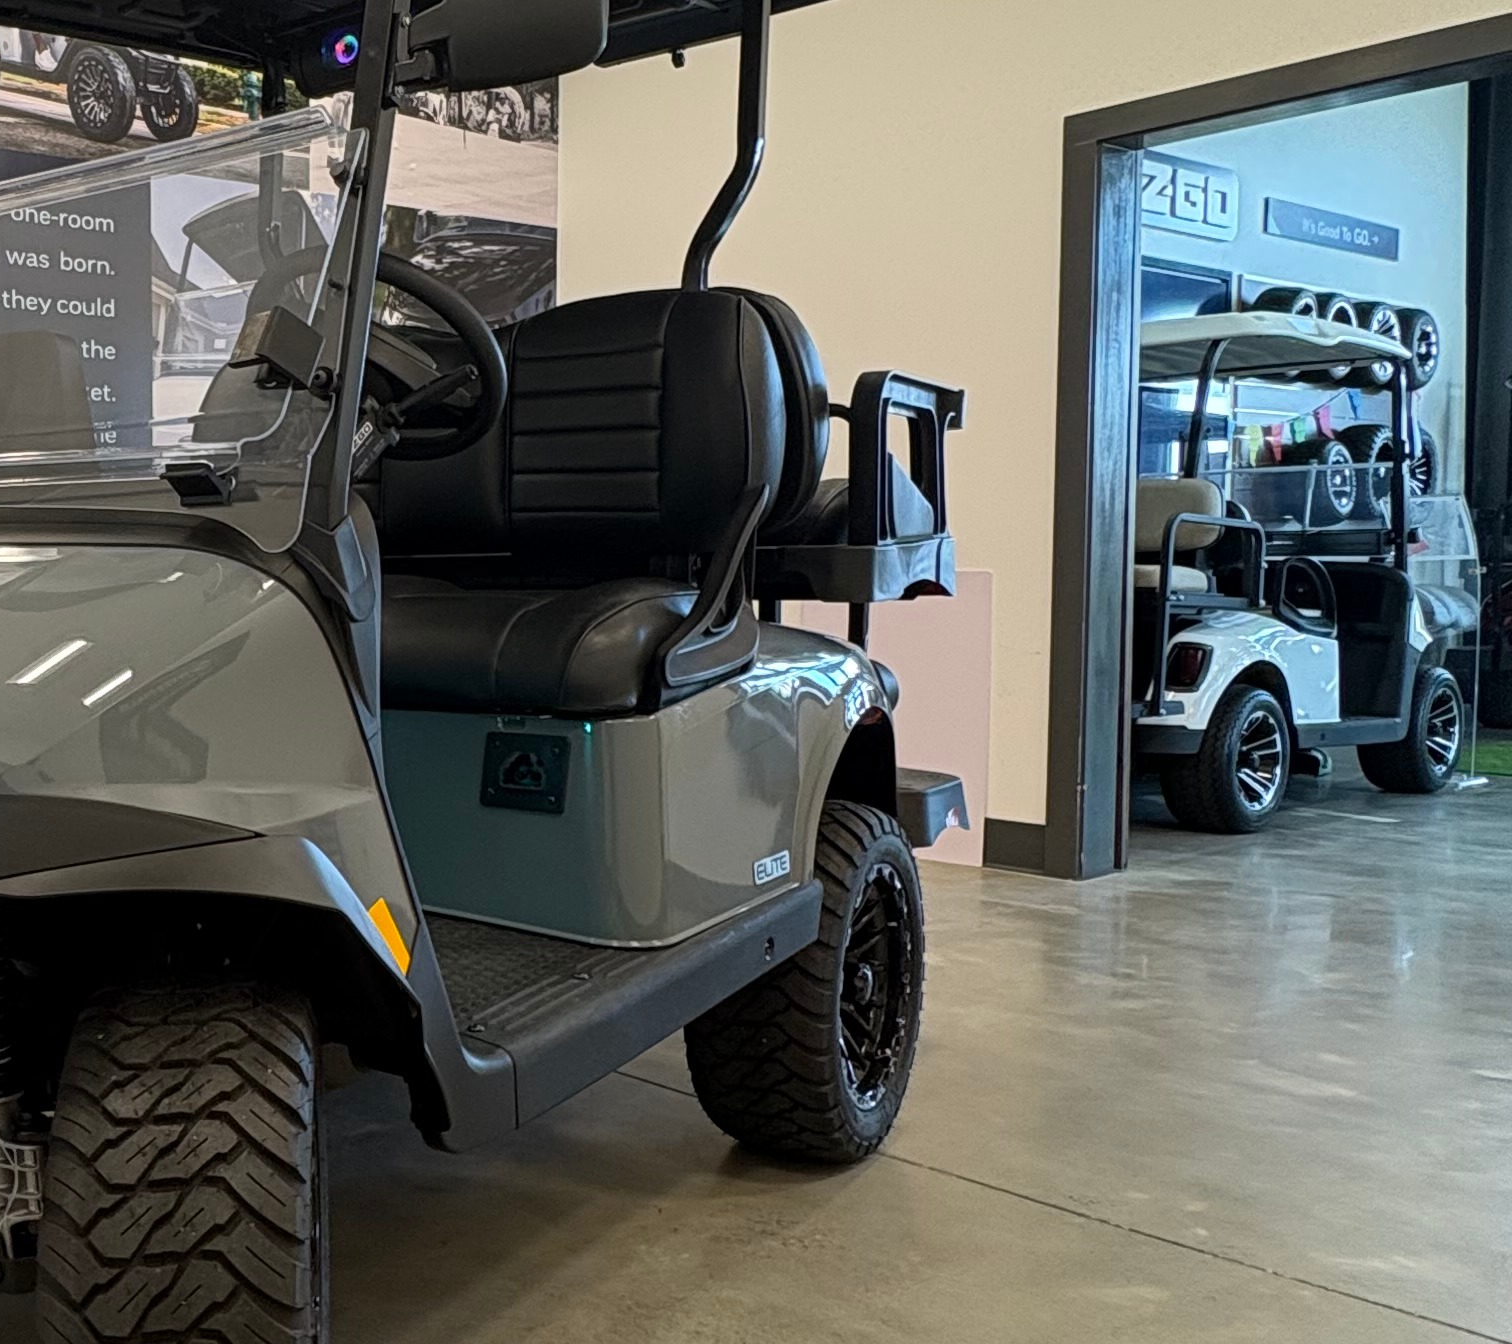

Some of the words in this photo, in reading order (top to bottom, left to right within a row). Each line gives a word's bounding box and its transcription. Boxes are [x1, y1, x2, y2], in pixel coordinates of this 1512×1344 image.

[1142, 159, 1234, 228] ZGO
[11, 208, 114, 233] one-room
[1317, 221, 1340, 239] Good
[1342, 226, 1352, 242] To
[6, 250, 50, 269] was
[60, 250, 115, 276] born.
[2, 289, 52, 315] they
[57, 298, 115, 318] could
[81, 339, 116, 360] the
[756, 854, 787, 881] ELITE
